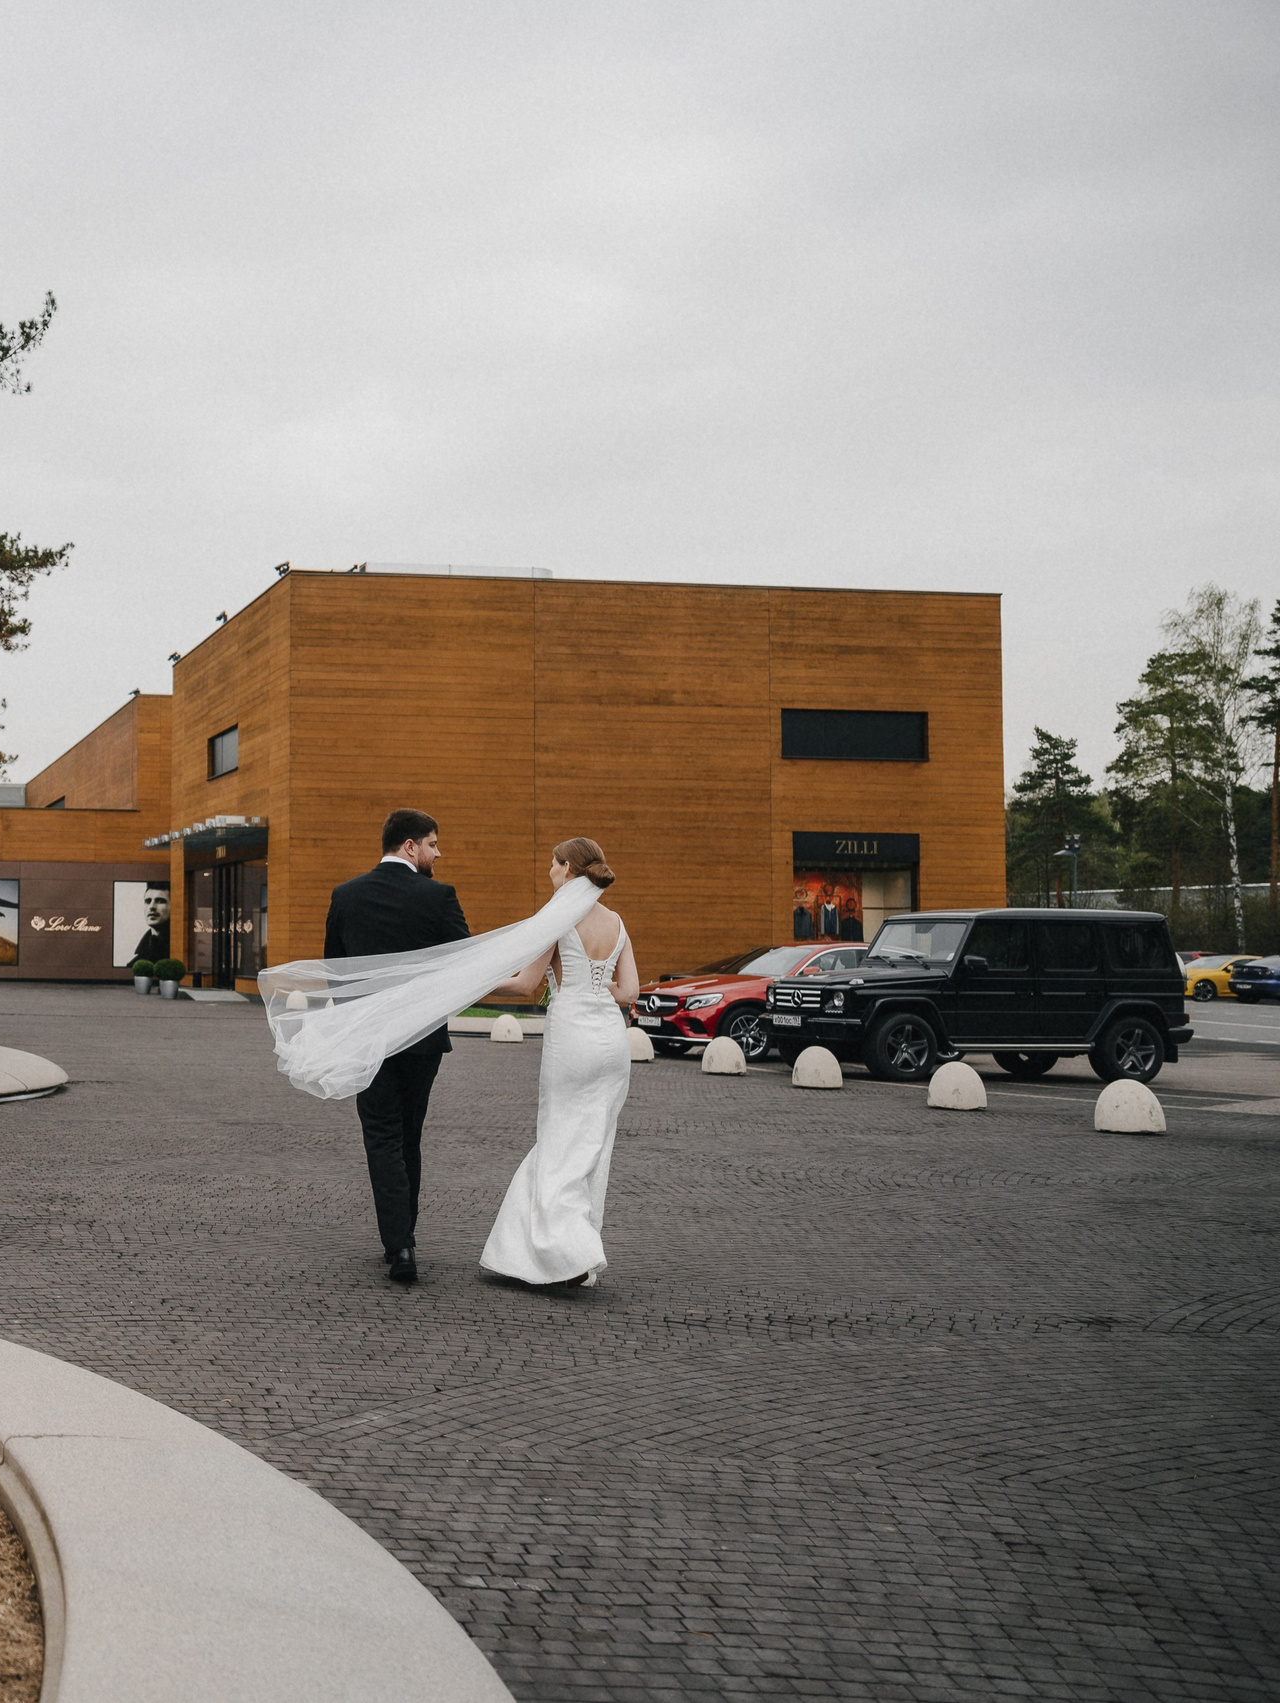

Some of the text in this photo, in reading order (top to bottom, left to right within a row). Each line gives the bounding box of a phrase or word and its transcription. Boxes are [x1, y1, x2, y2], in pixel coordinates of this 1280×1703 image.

[835, 840, 878, 855] ZILLI
[44, 916, 101, 931] Loro Piana
